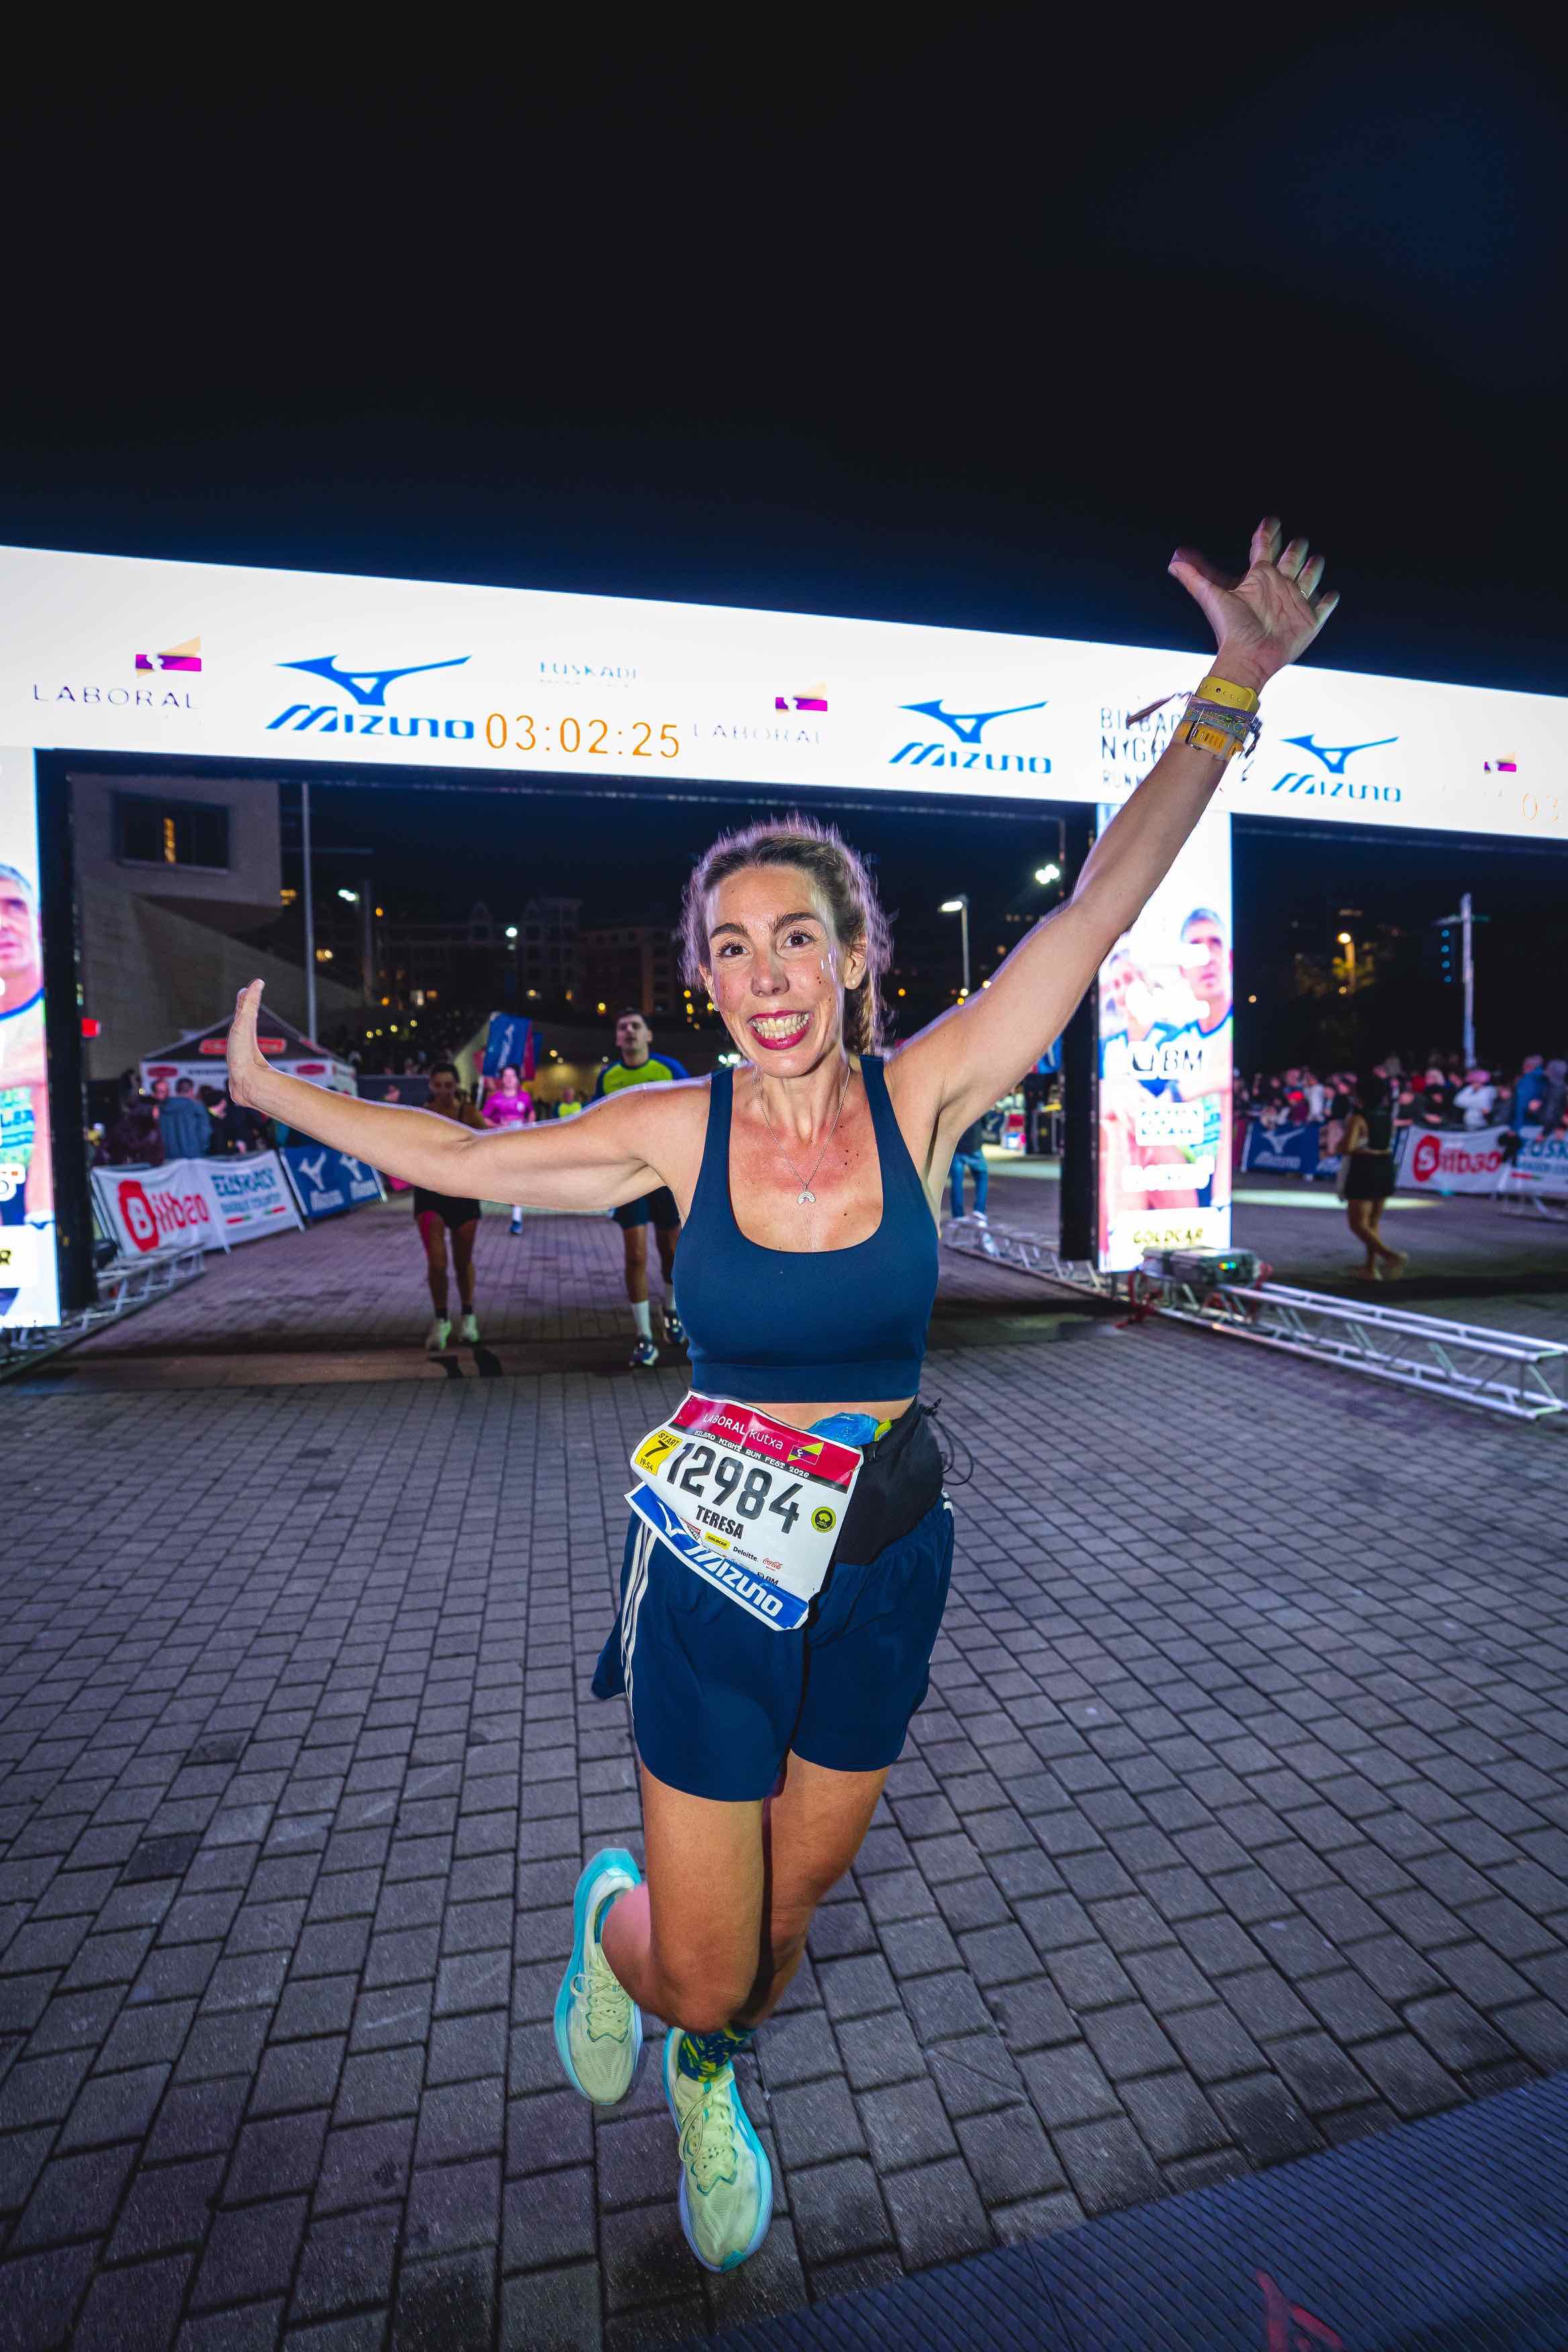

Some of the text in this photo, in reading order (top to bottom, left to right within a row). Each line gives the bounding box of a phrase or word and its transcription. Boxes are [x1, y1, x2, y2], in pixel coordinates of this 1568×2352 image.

[32, 683, 199, 709] LABORAL
[265, 703, 474, 739] MIZUNO
[485, 713, 681, 758] 03:02:25
[888, 742, 1052, 774] MIZUNO
[1271, 773, 1401, 803] MIZUNO
[658, 1432, 680, 1447] START
[702, 1412, 784, 1451] LABORAL kutxa
[640, 1457, 654, 1472] 19:54
[644, 1439, 670, 1458] 7
[694, 1430, 716, 1441] BILBAO
[745, 1449, 762, 1460] RUN
[765, 1456, 786, 1469] FEST
[666, 1442, 804, 1534] 12984
[695, 1504, 744, 1540] TERESA
[707, 1535, 728, 1548] GOLDCAR
